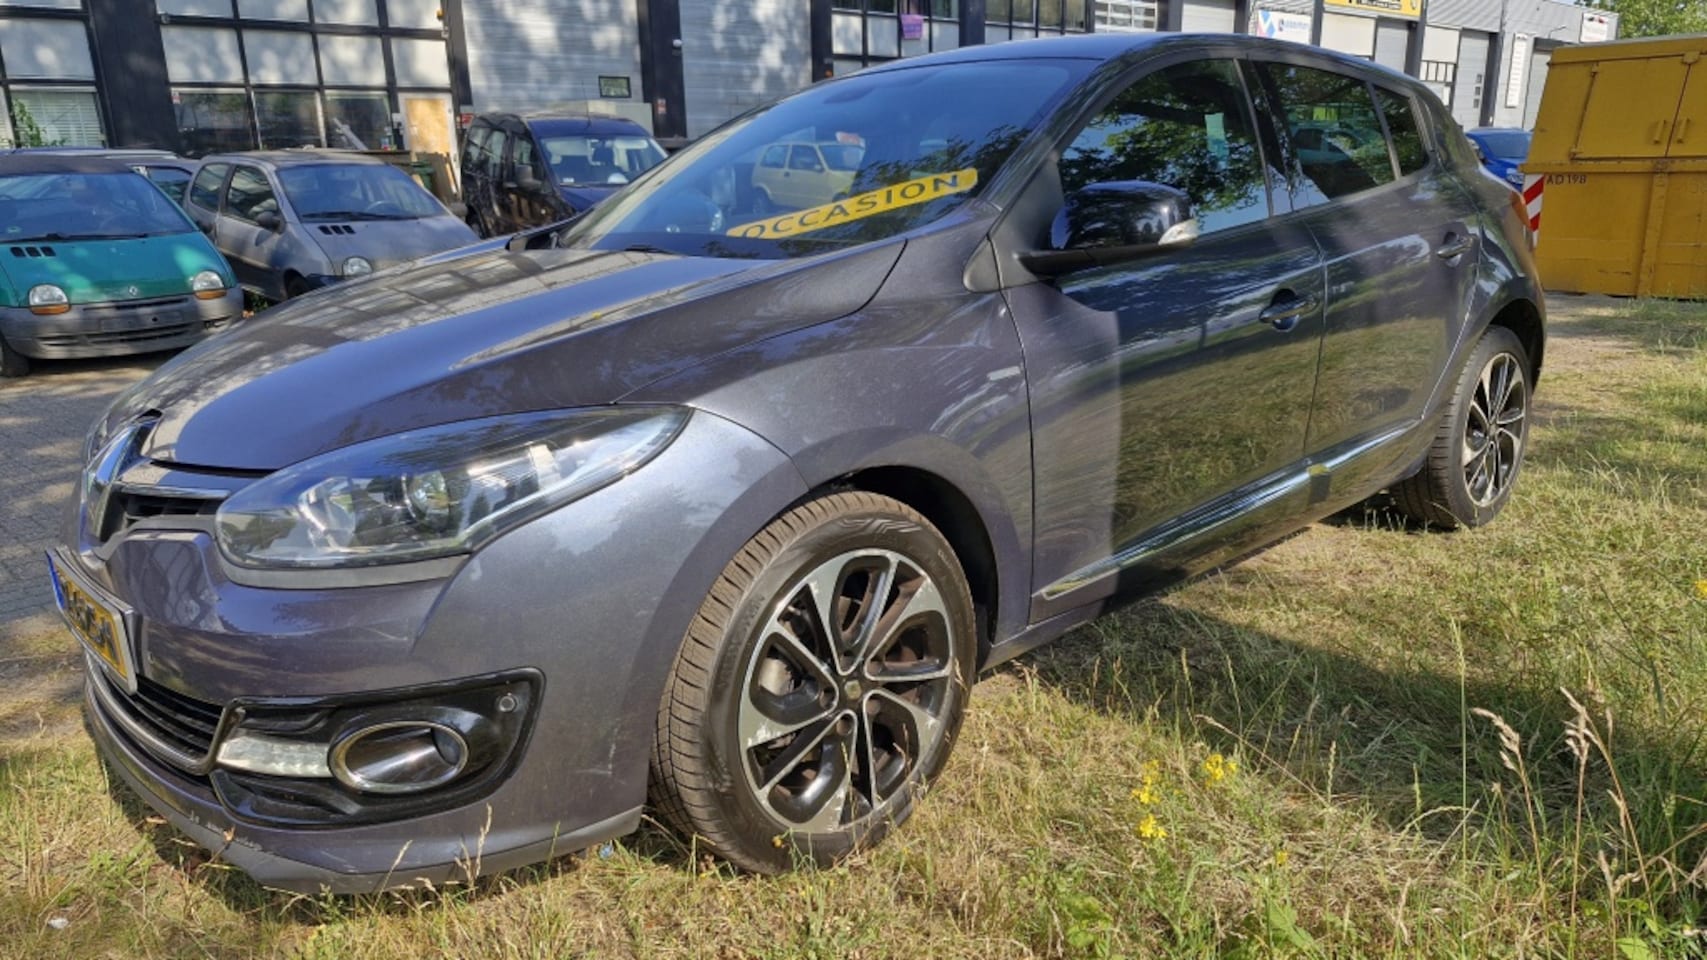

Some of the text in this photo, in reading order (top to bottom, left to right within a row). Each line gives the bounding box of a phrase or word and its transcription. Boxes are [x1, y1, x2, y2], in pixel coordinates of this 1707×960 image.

[1546, 172, 1586, 185] AD 198
[741, 174, 960, 238] OCCASION
